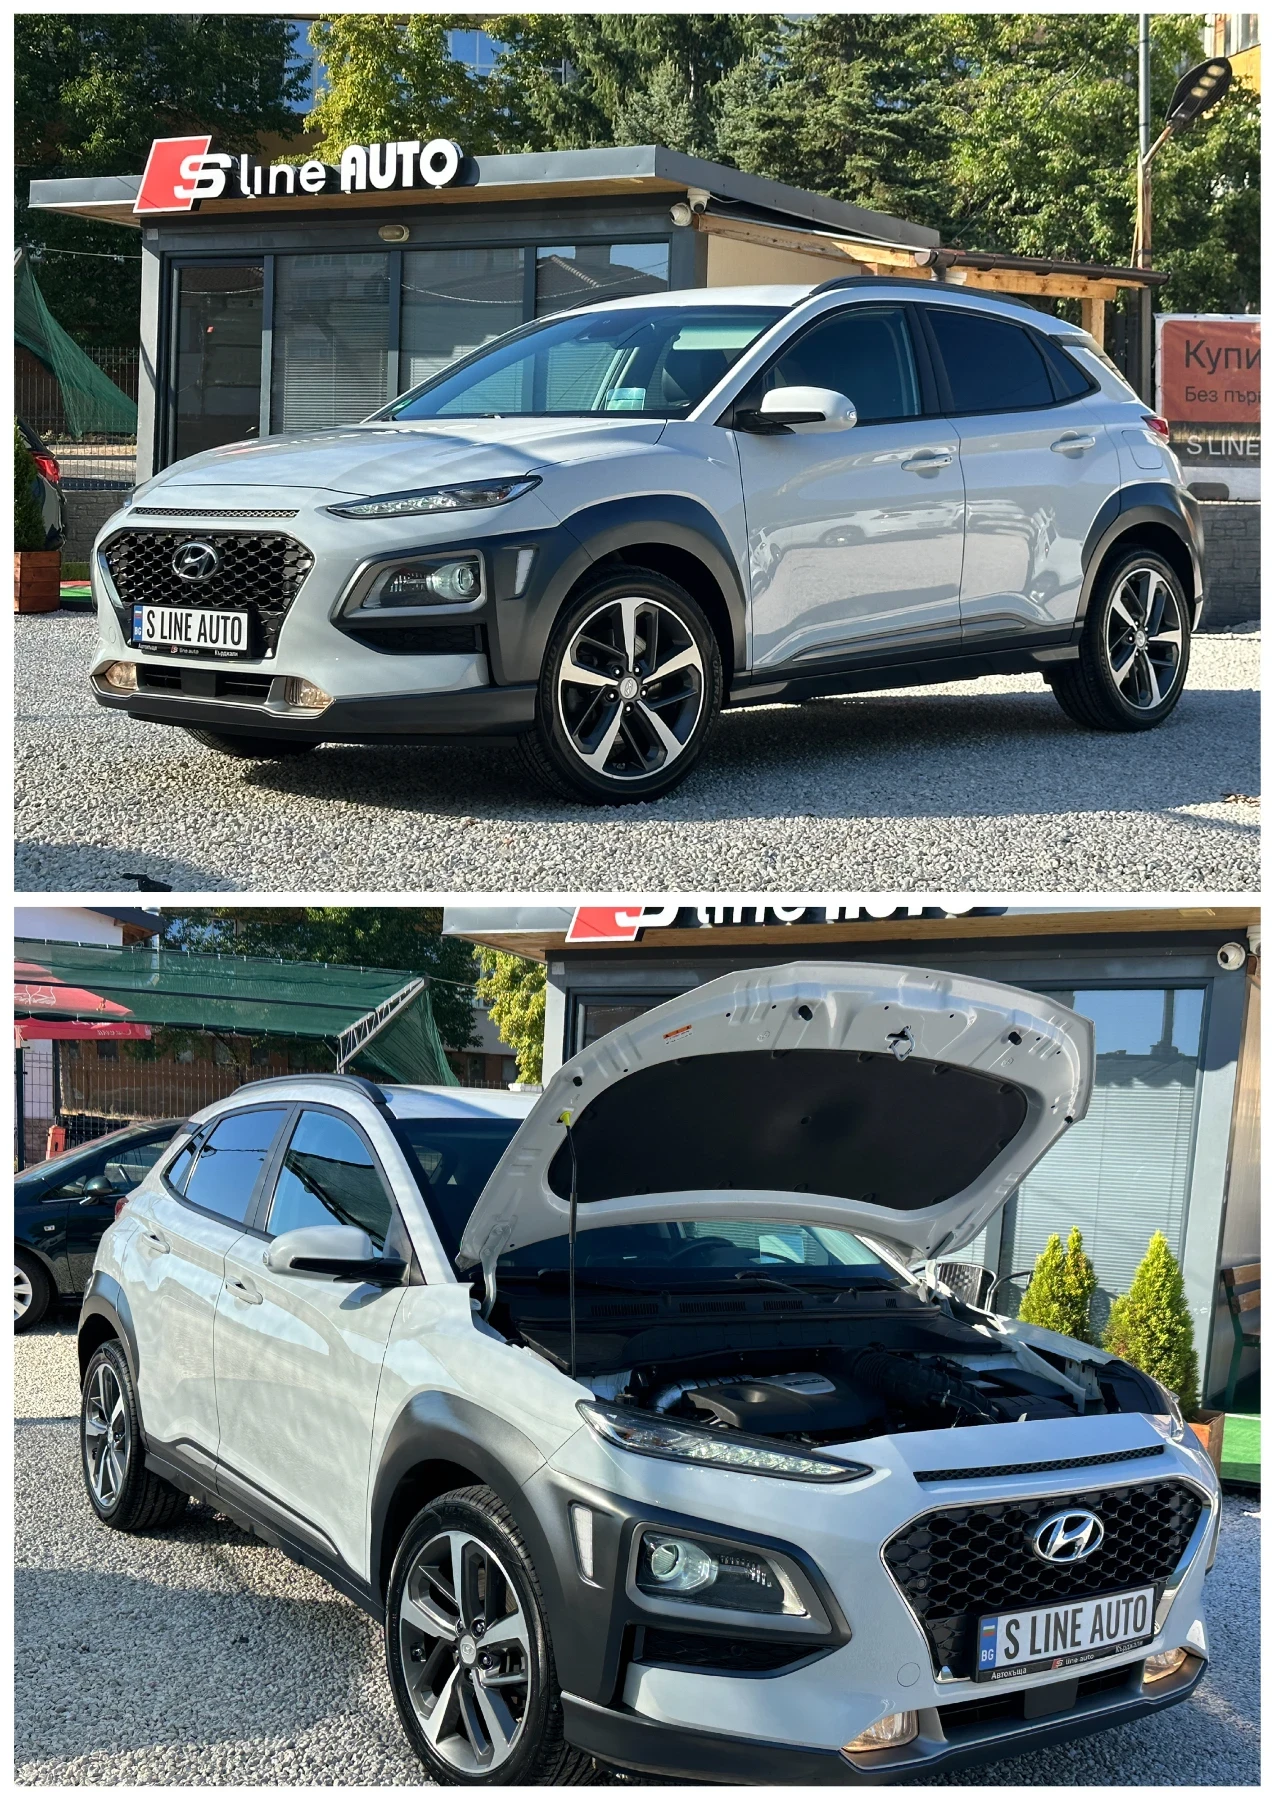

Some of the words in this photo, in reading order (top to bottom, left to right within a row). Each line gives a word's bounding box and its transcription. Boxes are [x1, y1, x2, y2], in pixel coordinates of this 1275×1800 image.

[240, 154, 326, 195] line
[341, 139, 458, 191] AUTO
[1185, 386, 1218, 403] Без
[1224, 391, 1261, 406] пър
[1186, 434, 1202, 456] S
[1208, 435, 1260, 457] LINE
[146, 609, 155, 639] S
[160, 611, 192, 642] LINE
[197, 613, 242, 646] AUTO
[1004, 1618, 1020, 1660] S
[1029, 1607, 1083, 1656] LINE
[1089, 1594, 1147, 1644] AUTO
[981, 1648, 994, 1661] BG
[1079, 1653, 1095, 1663] auto
[991, 1666, 1027, 1680] Автокъща
